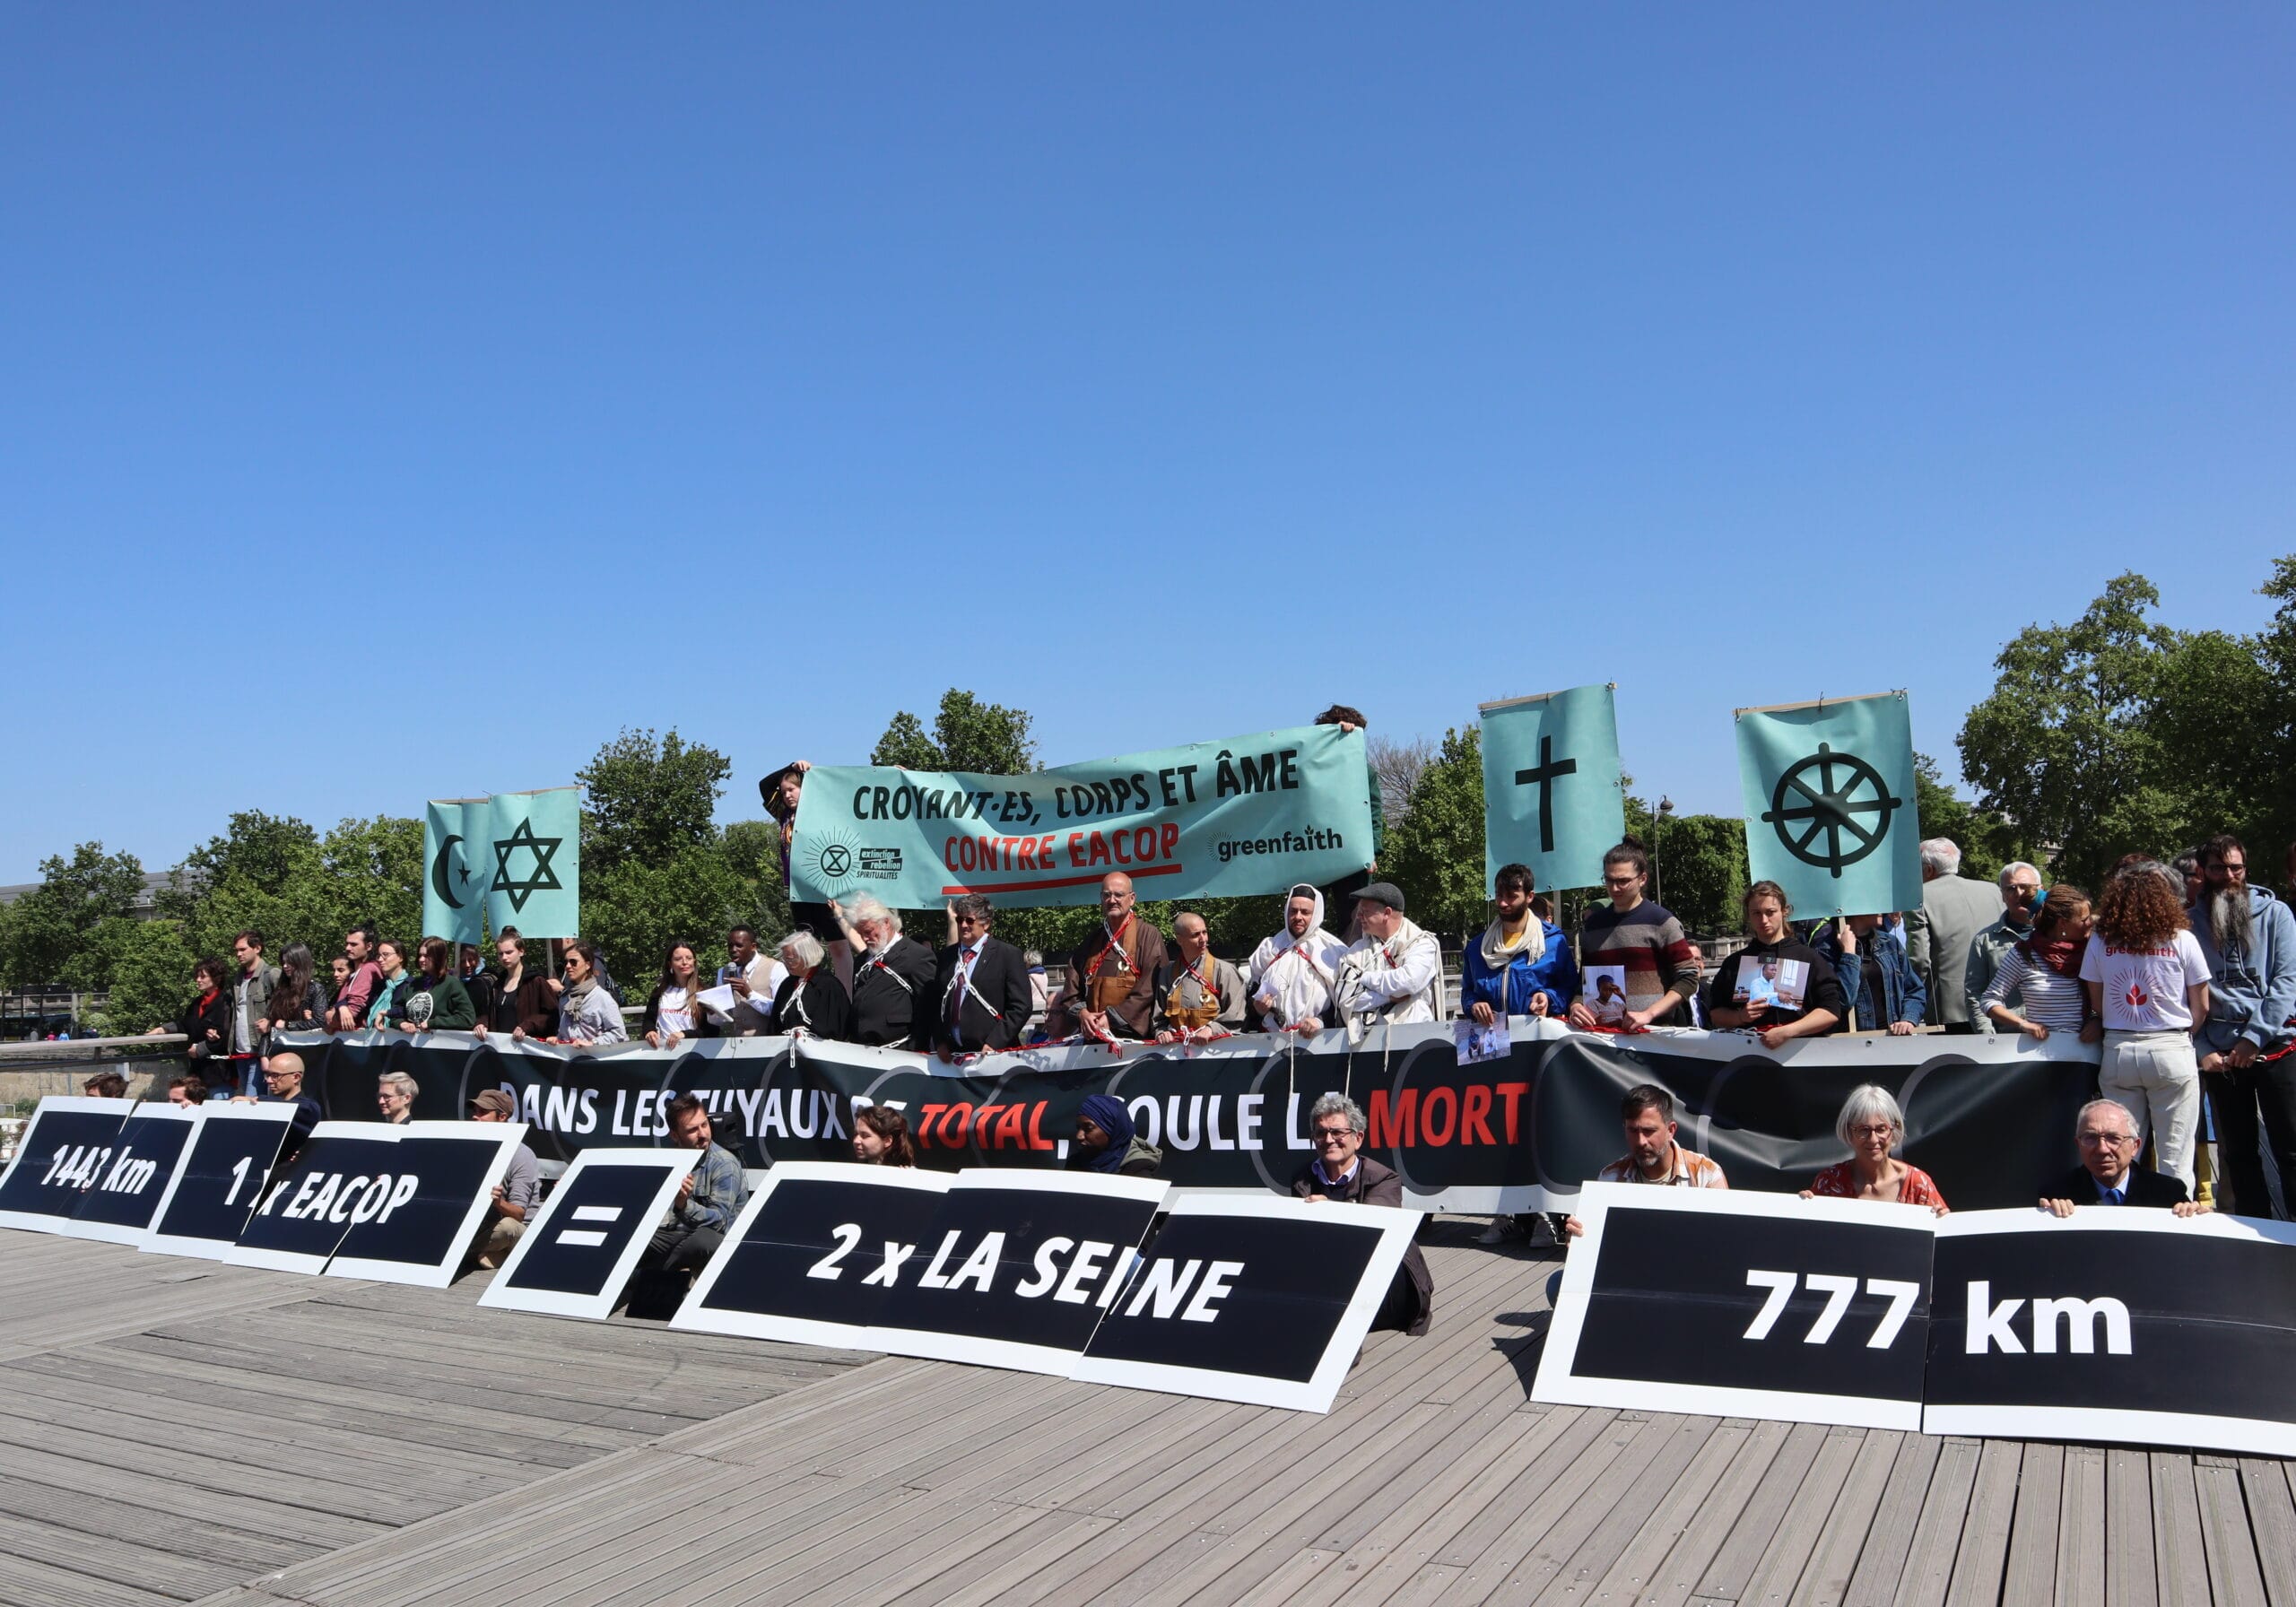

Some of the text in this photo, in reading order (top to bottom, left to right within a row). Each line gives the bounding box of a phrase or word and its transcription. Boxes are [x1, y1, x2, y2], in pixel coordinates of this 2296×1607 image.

[1055, 773, 1151, 819] CORPS
[1158, 764, 1198, 807] ET
[1214, 749, 1300, 798] ÂME
[861, 848, 896, 859] extinction
[870, 859, 901, 870] rebellion
[944, 822, 1180, 873] CONTRE EACOP
[1217, 824, 1343, 863] greenfaith
[612, 1090, 676, 1137] LES
[918, 1100, 1070, 1160] TOTAL,
[1112, 1093, 1265, 1151] OULE
[1285, 1090, 1343, 1151] L
[1369, 1082, 1530, 1149] MORT
[40, 1144, 157, 1194] 1443 km
[224, 1156, 253, 1205] 1
[281, 1171, 419, 1225] EACOP
[805, 1222, 1246, 1323] 2 x LA SEINE
[1742, 1269, 2133, 1355] 777 km
